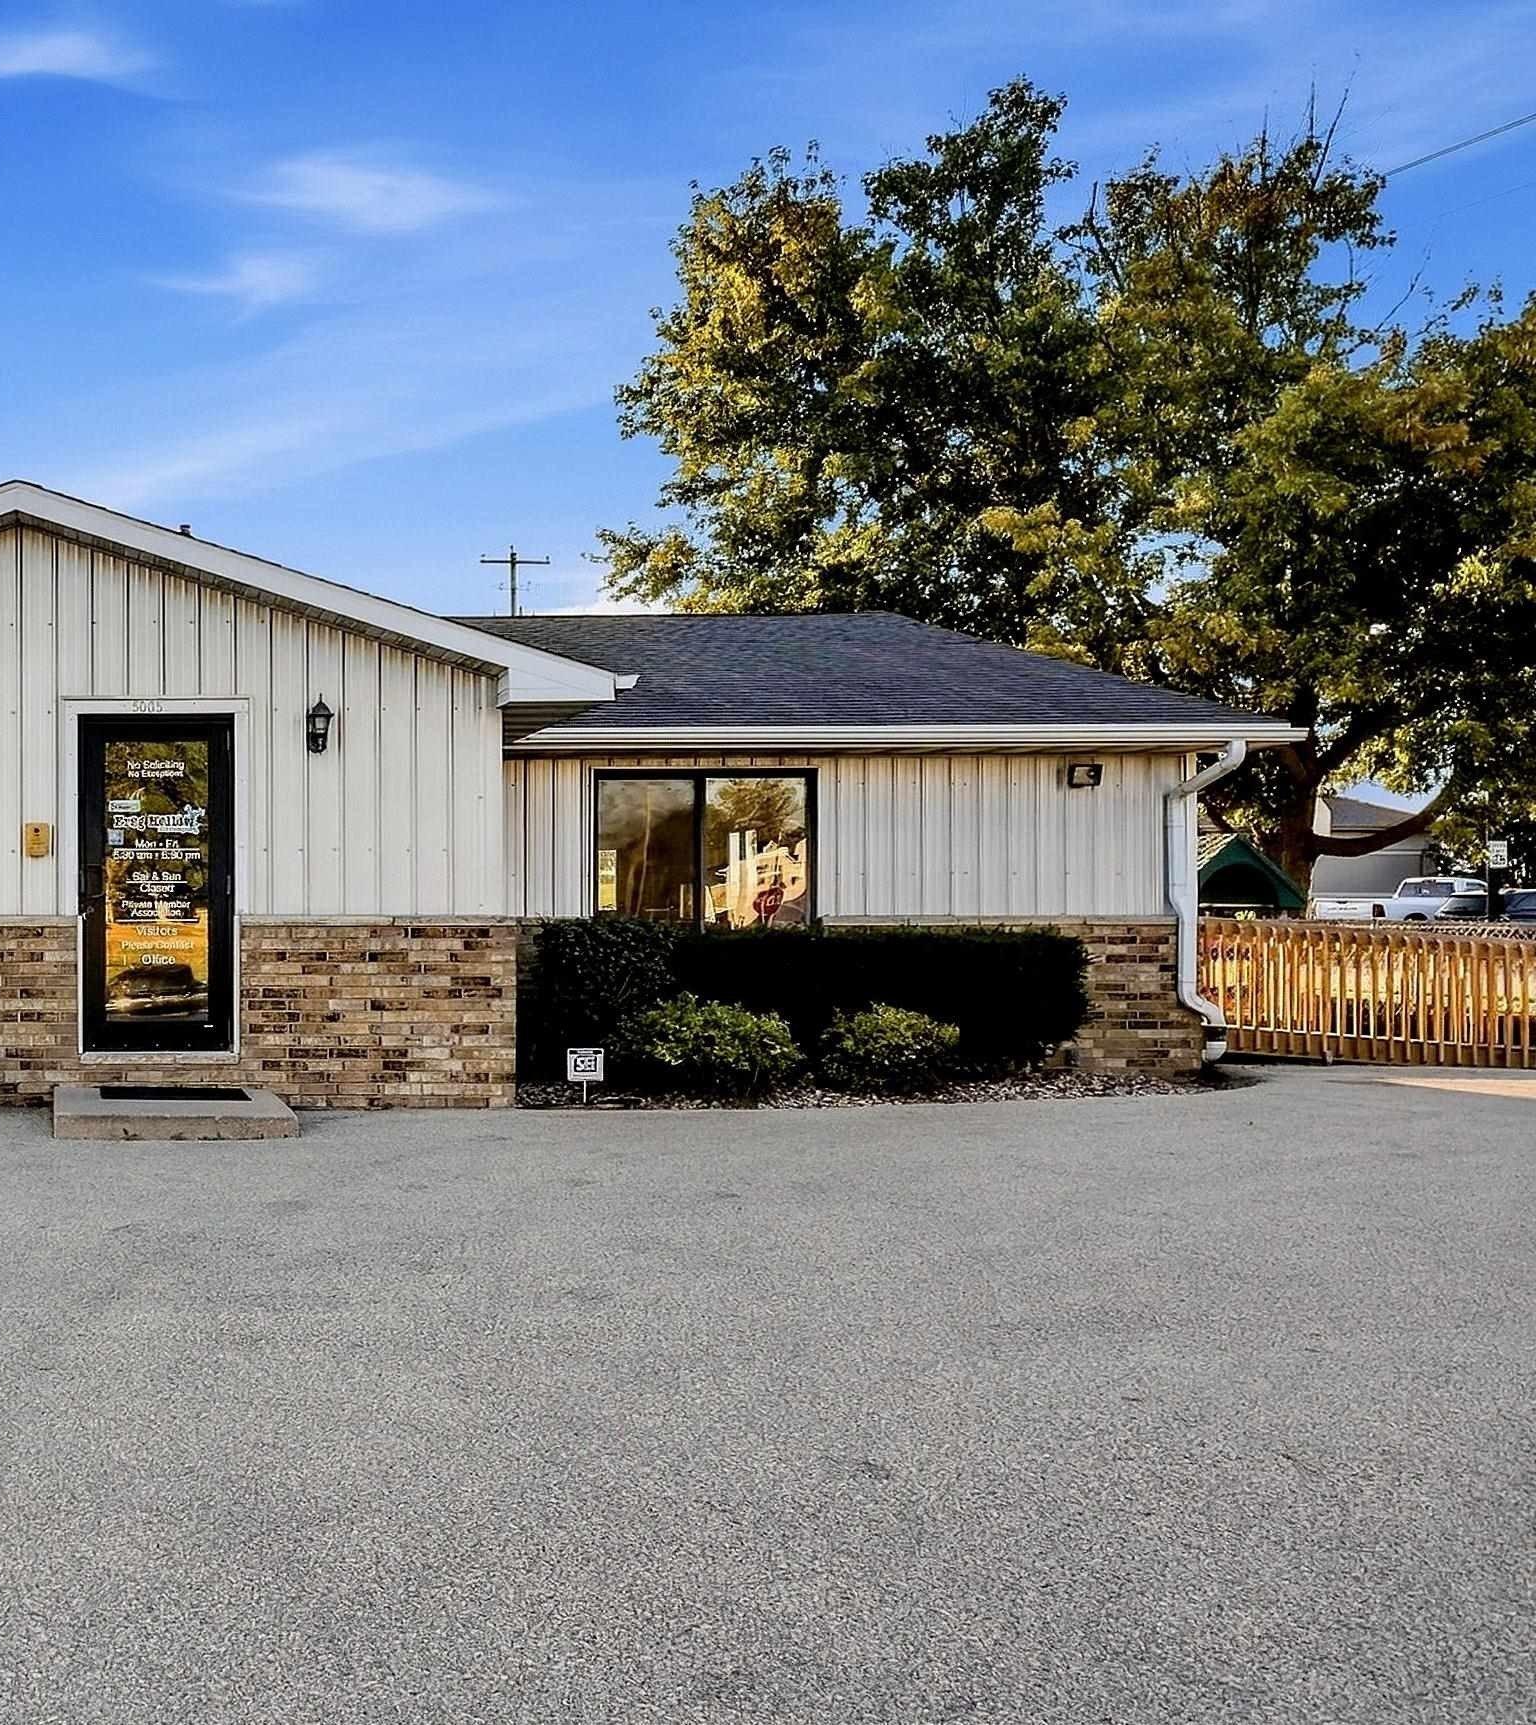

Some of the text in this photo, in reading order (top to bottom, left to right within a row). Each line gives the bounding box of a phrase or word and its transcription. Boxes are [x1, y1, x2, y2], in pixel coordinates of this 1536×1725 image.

[127, 760, 185, 771] No Soliciting
[128, 770, 184, 779] No Exceptions
[135, 839, 156, 848] Mon
[185, 852, 201, 862] pm
[132, 871, 182, 881] Sat & Sun
[139, 884, 175, 893] Closed
[121, 900, 153, 909] Private
[136, 926, 177, 936] Visitors
[141, 955, 176, 965] Office
